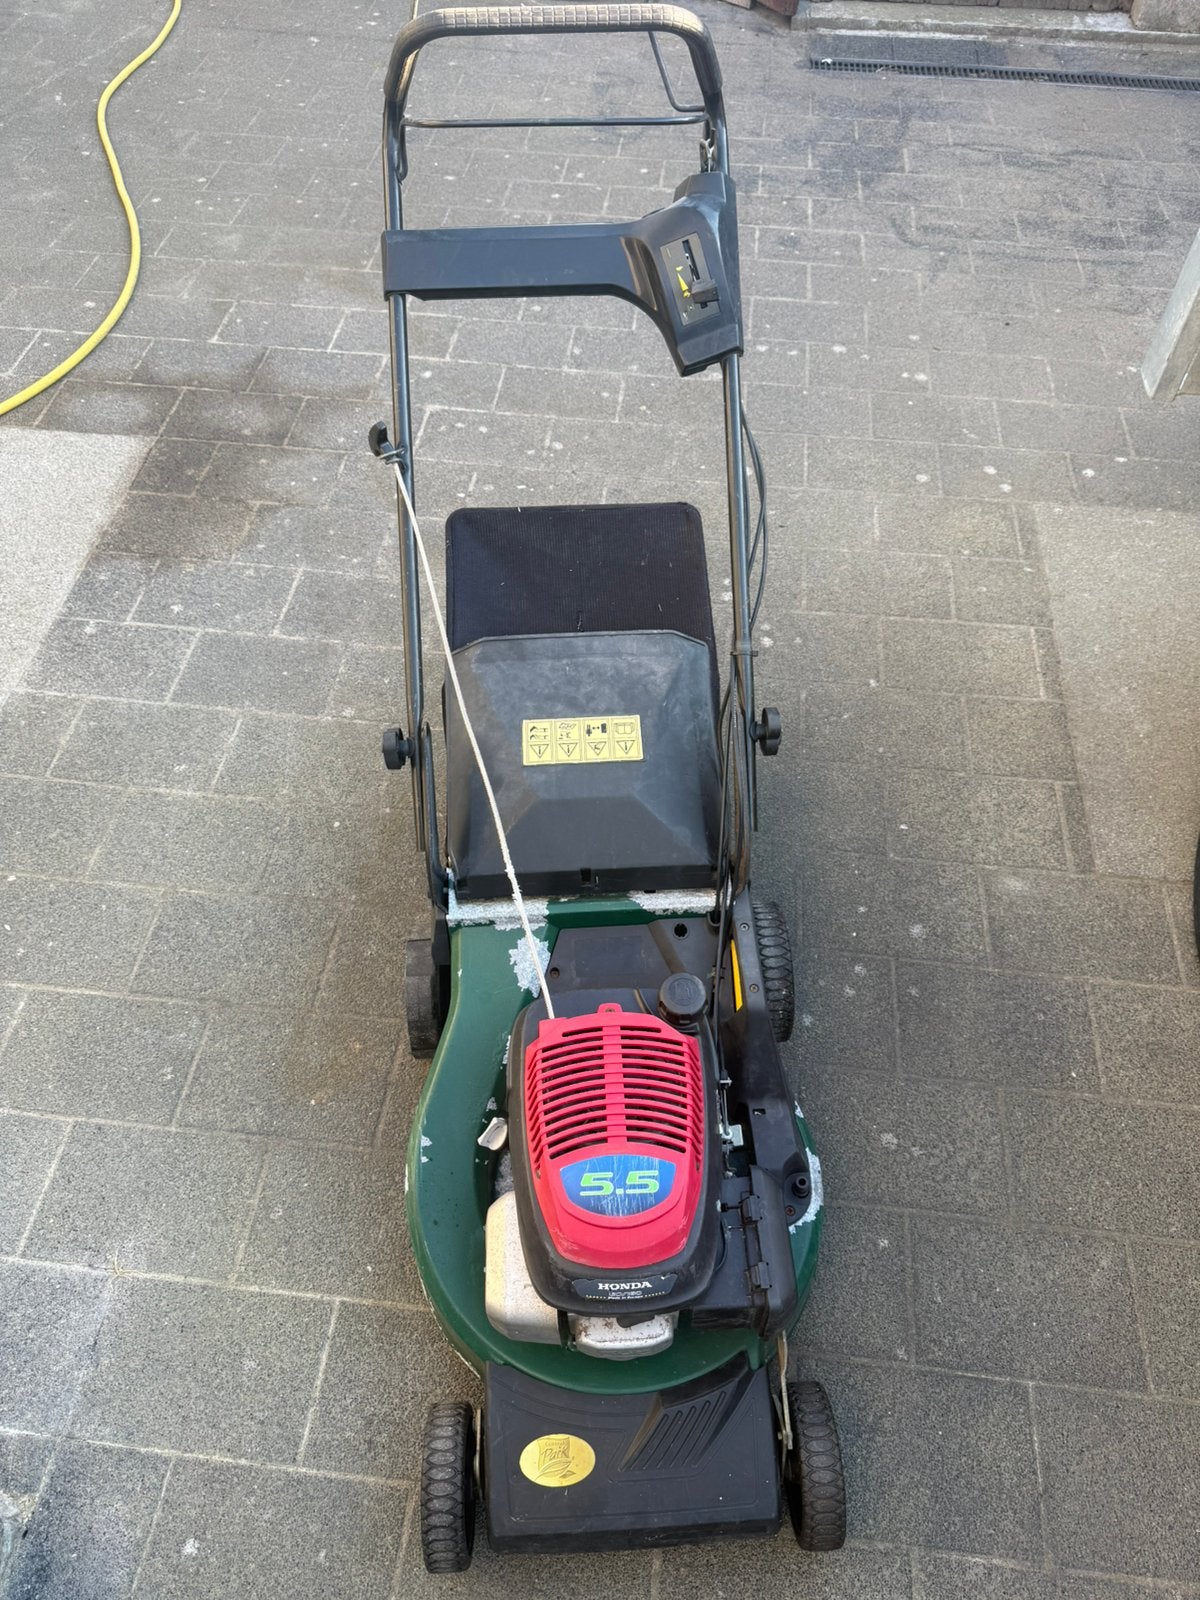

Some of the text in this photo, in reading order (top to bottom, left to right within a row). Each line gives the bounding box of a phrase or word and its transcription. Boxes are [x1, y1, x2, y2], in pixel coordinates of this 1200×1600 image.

[580, 1170, 660, 1196] 5.5
[598, 1281, 653, 1290] HONDA
[540, 1446, 570, 1464] Park
